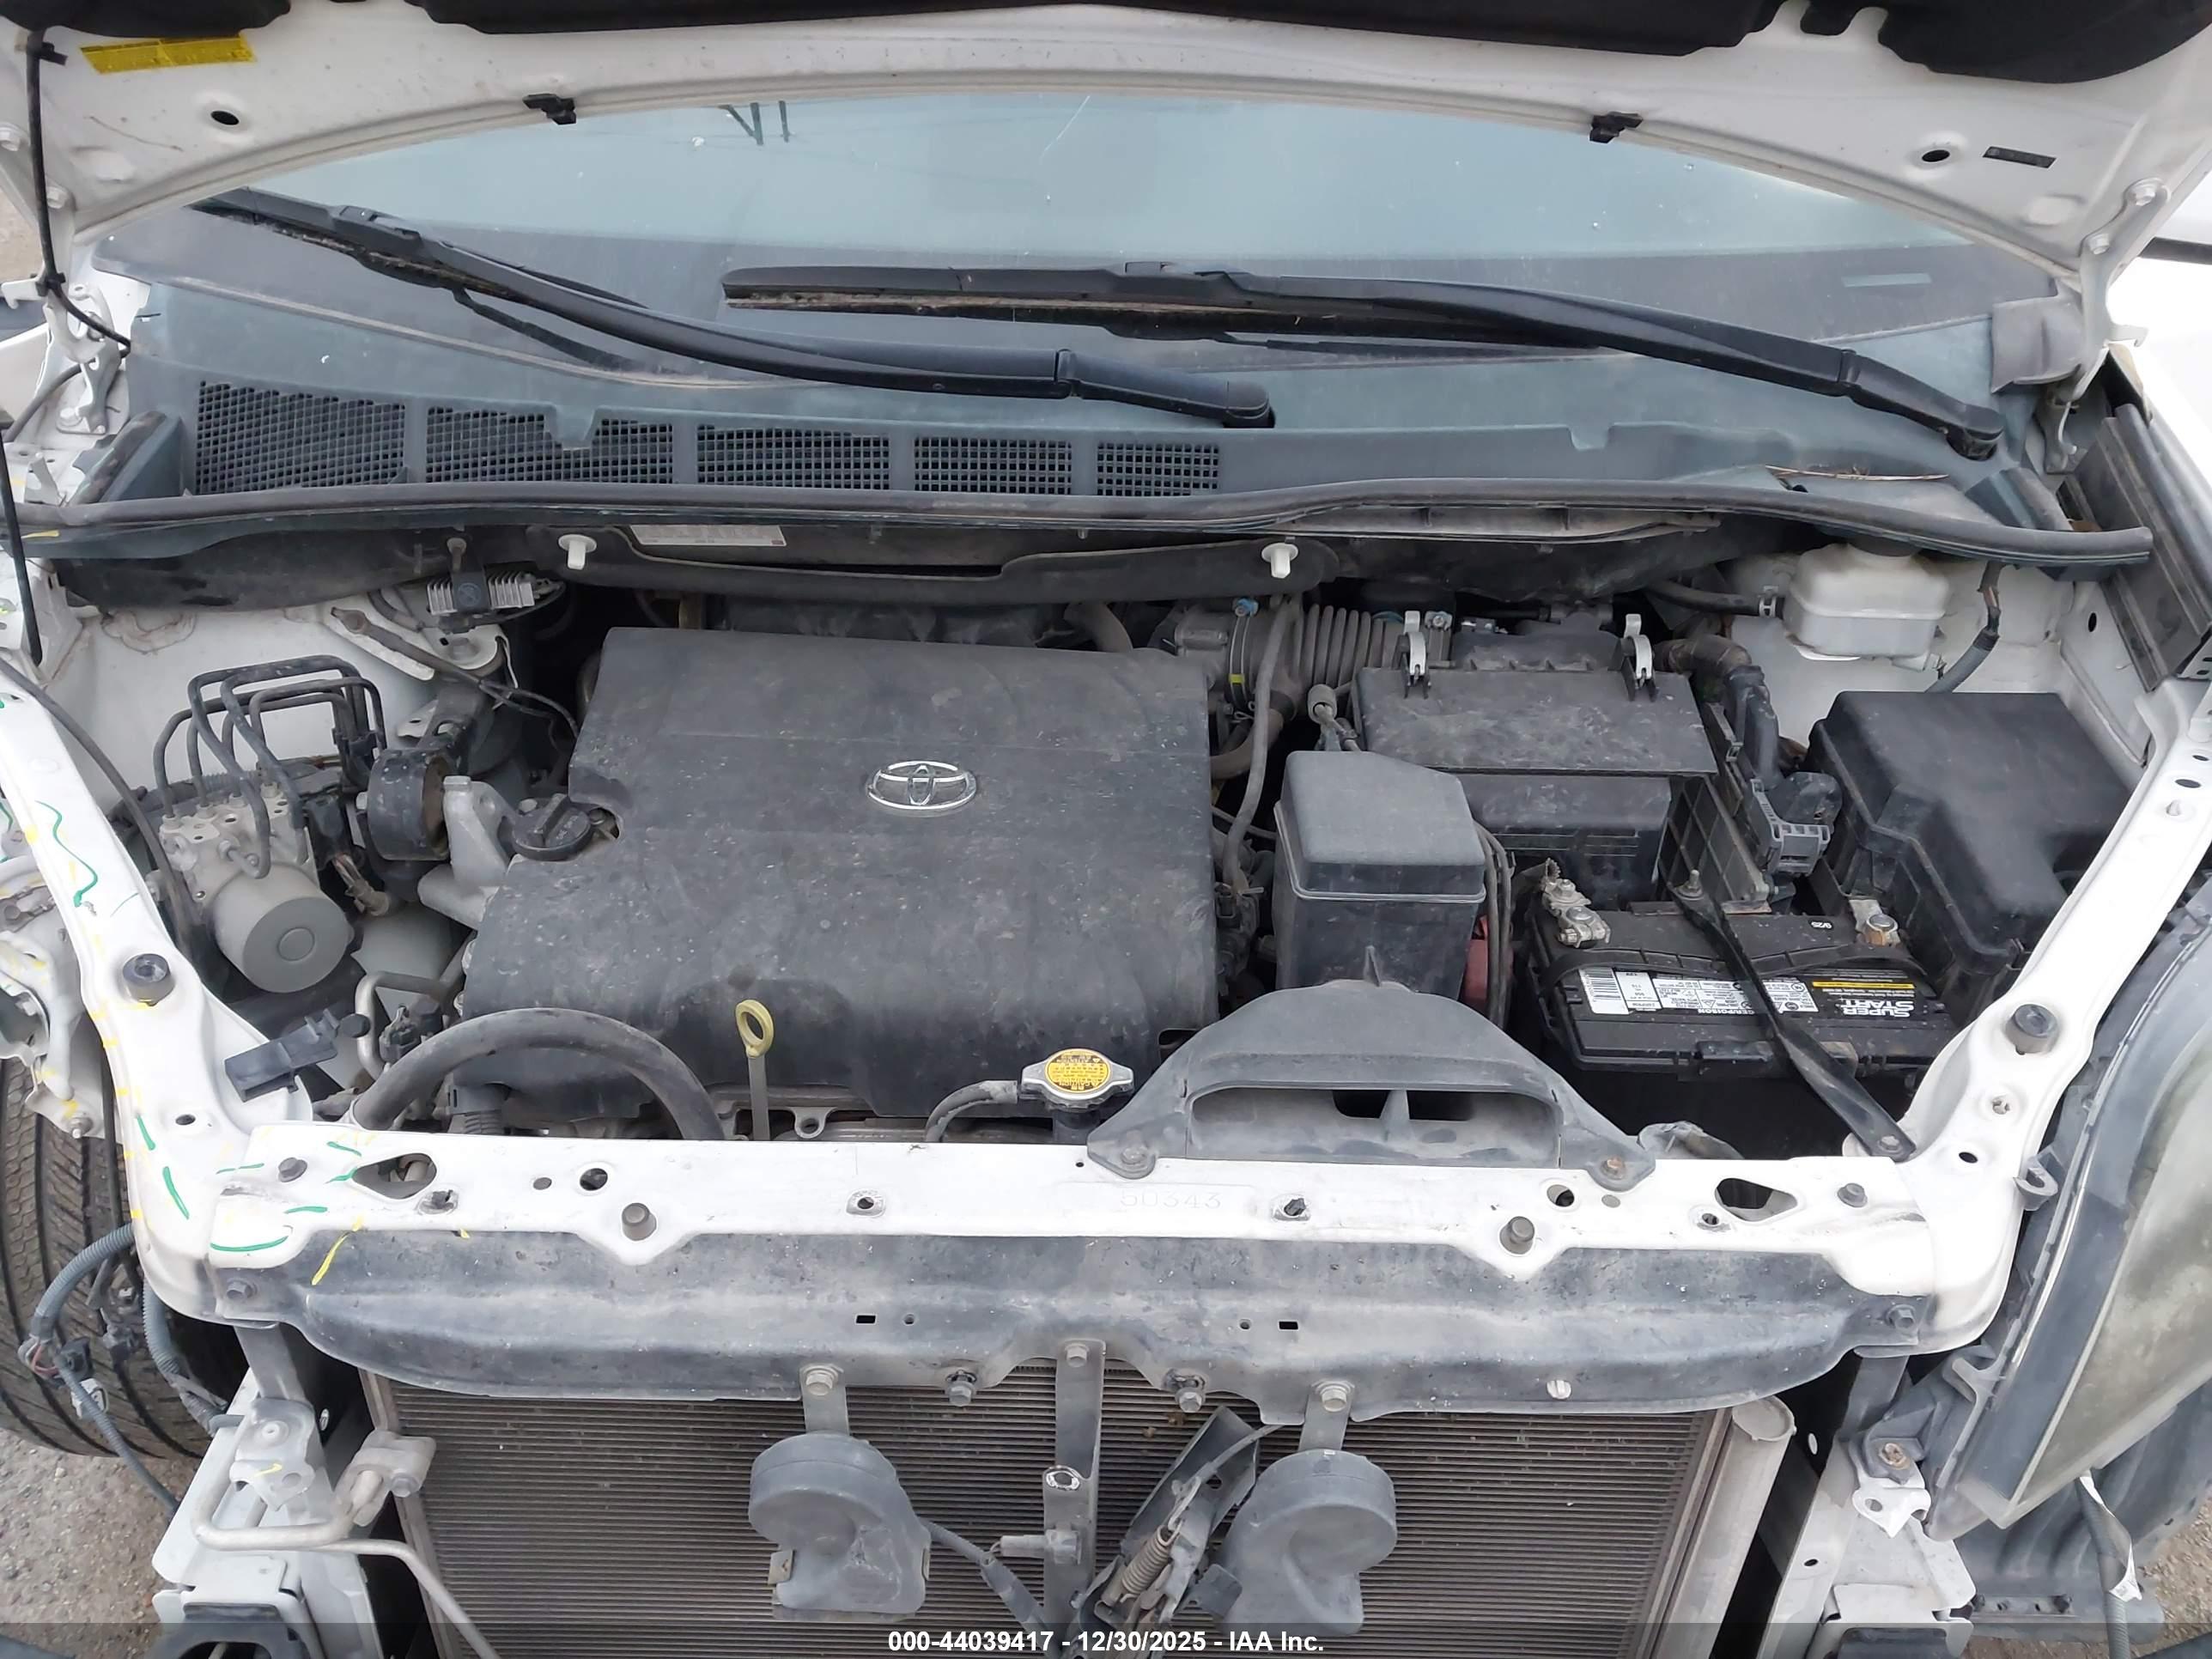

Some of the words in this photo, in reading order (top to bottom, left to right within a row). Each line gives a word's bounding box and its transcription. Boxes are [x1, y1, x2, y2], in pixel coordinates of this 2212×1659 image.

[1840, 1000, 1915, 1011] START
[1843, 1007, 1911, 1018] SUPER
[1120, 1188, 1222, 1210] 50343
